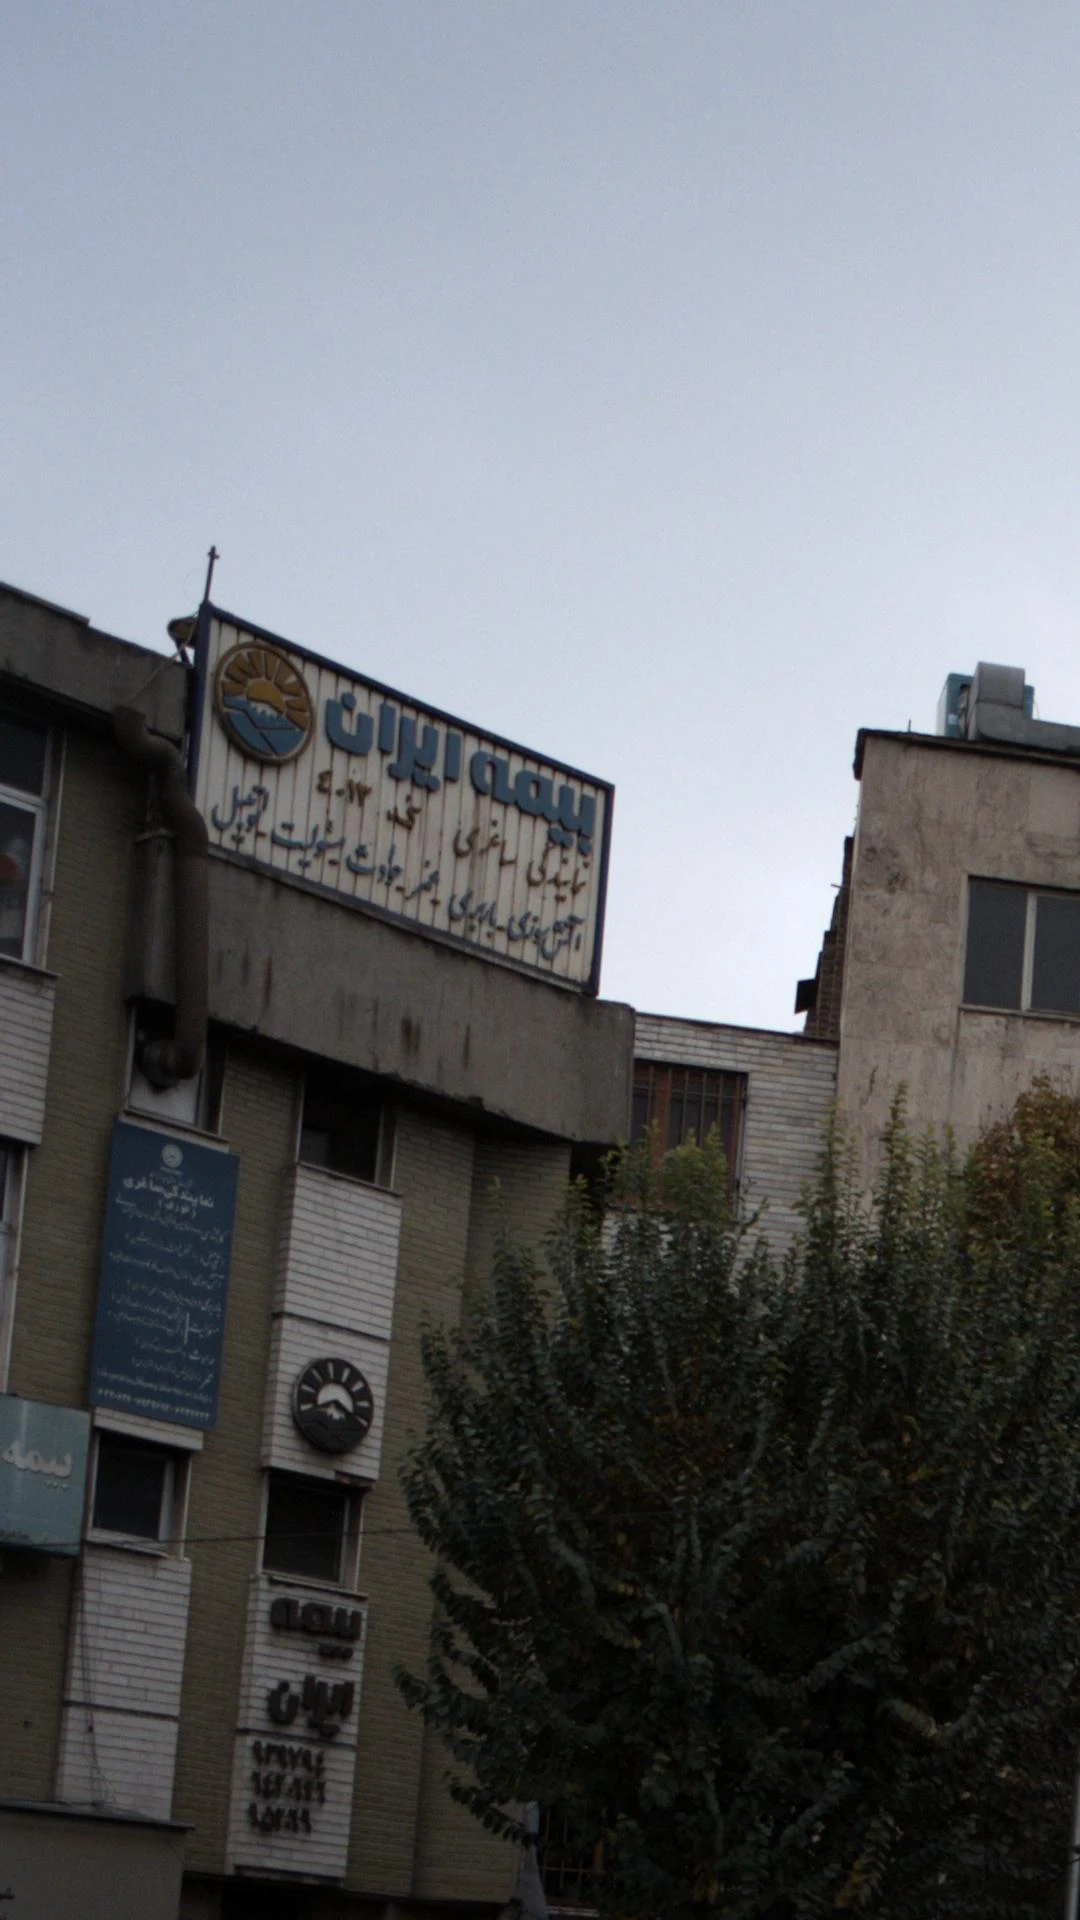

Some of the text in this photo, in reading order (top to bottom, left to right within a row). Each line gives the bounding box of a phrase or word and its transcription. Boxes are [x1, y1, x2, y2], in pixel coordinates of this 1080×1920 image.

[324, 692, 597, 855] بیمه ایران
[527, 841, 591, 902] نمایندگی
[2, 1440, 73, 1491] بیمه
[269, 1596, 363, 1661] بیمه
[267, 1674, 355, 1740] ایران
